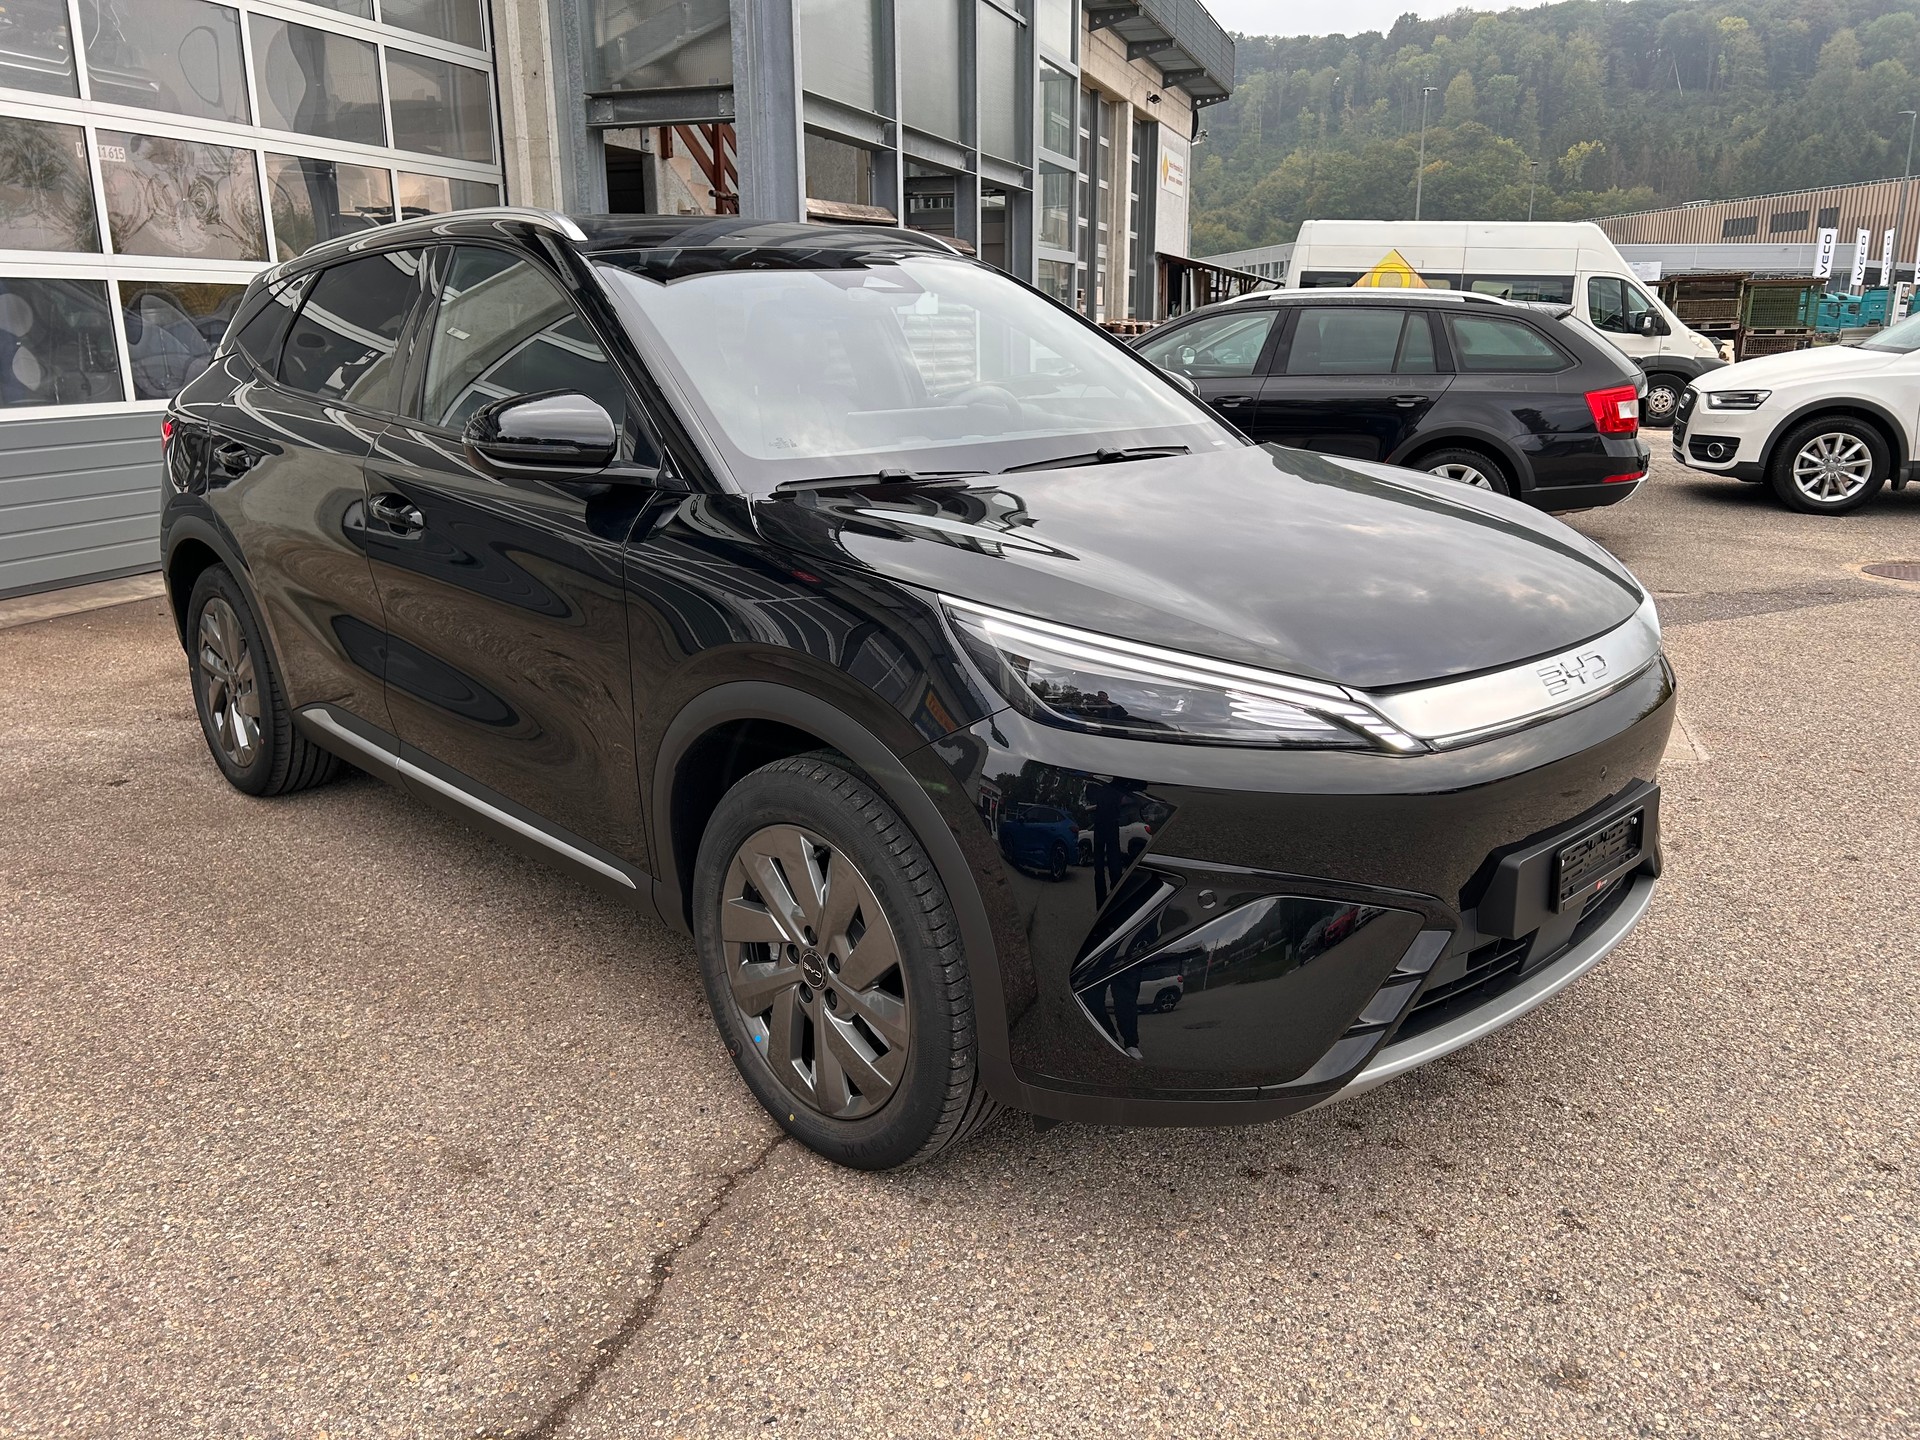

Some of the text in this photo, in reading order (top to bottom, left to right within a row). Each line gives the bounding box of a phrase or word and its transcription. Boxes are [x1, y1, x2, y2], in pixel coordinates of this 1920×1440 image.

[1819, 233, 1832, 275] VECO
[1856, 235, 1867, 280] IVECO
[1536, 651, 1609, 696] BYD
[803, 961, 822, 979] BYD
